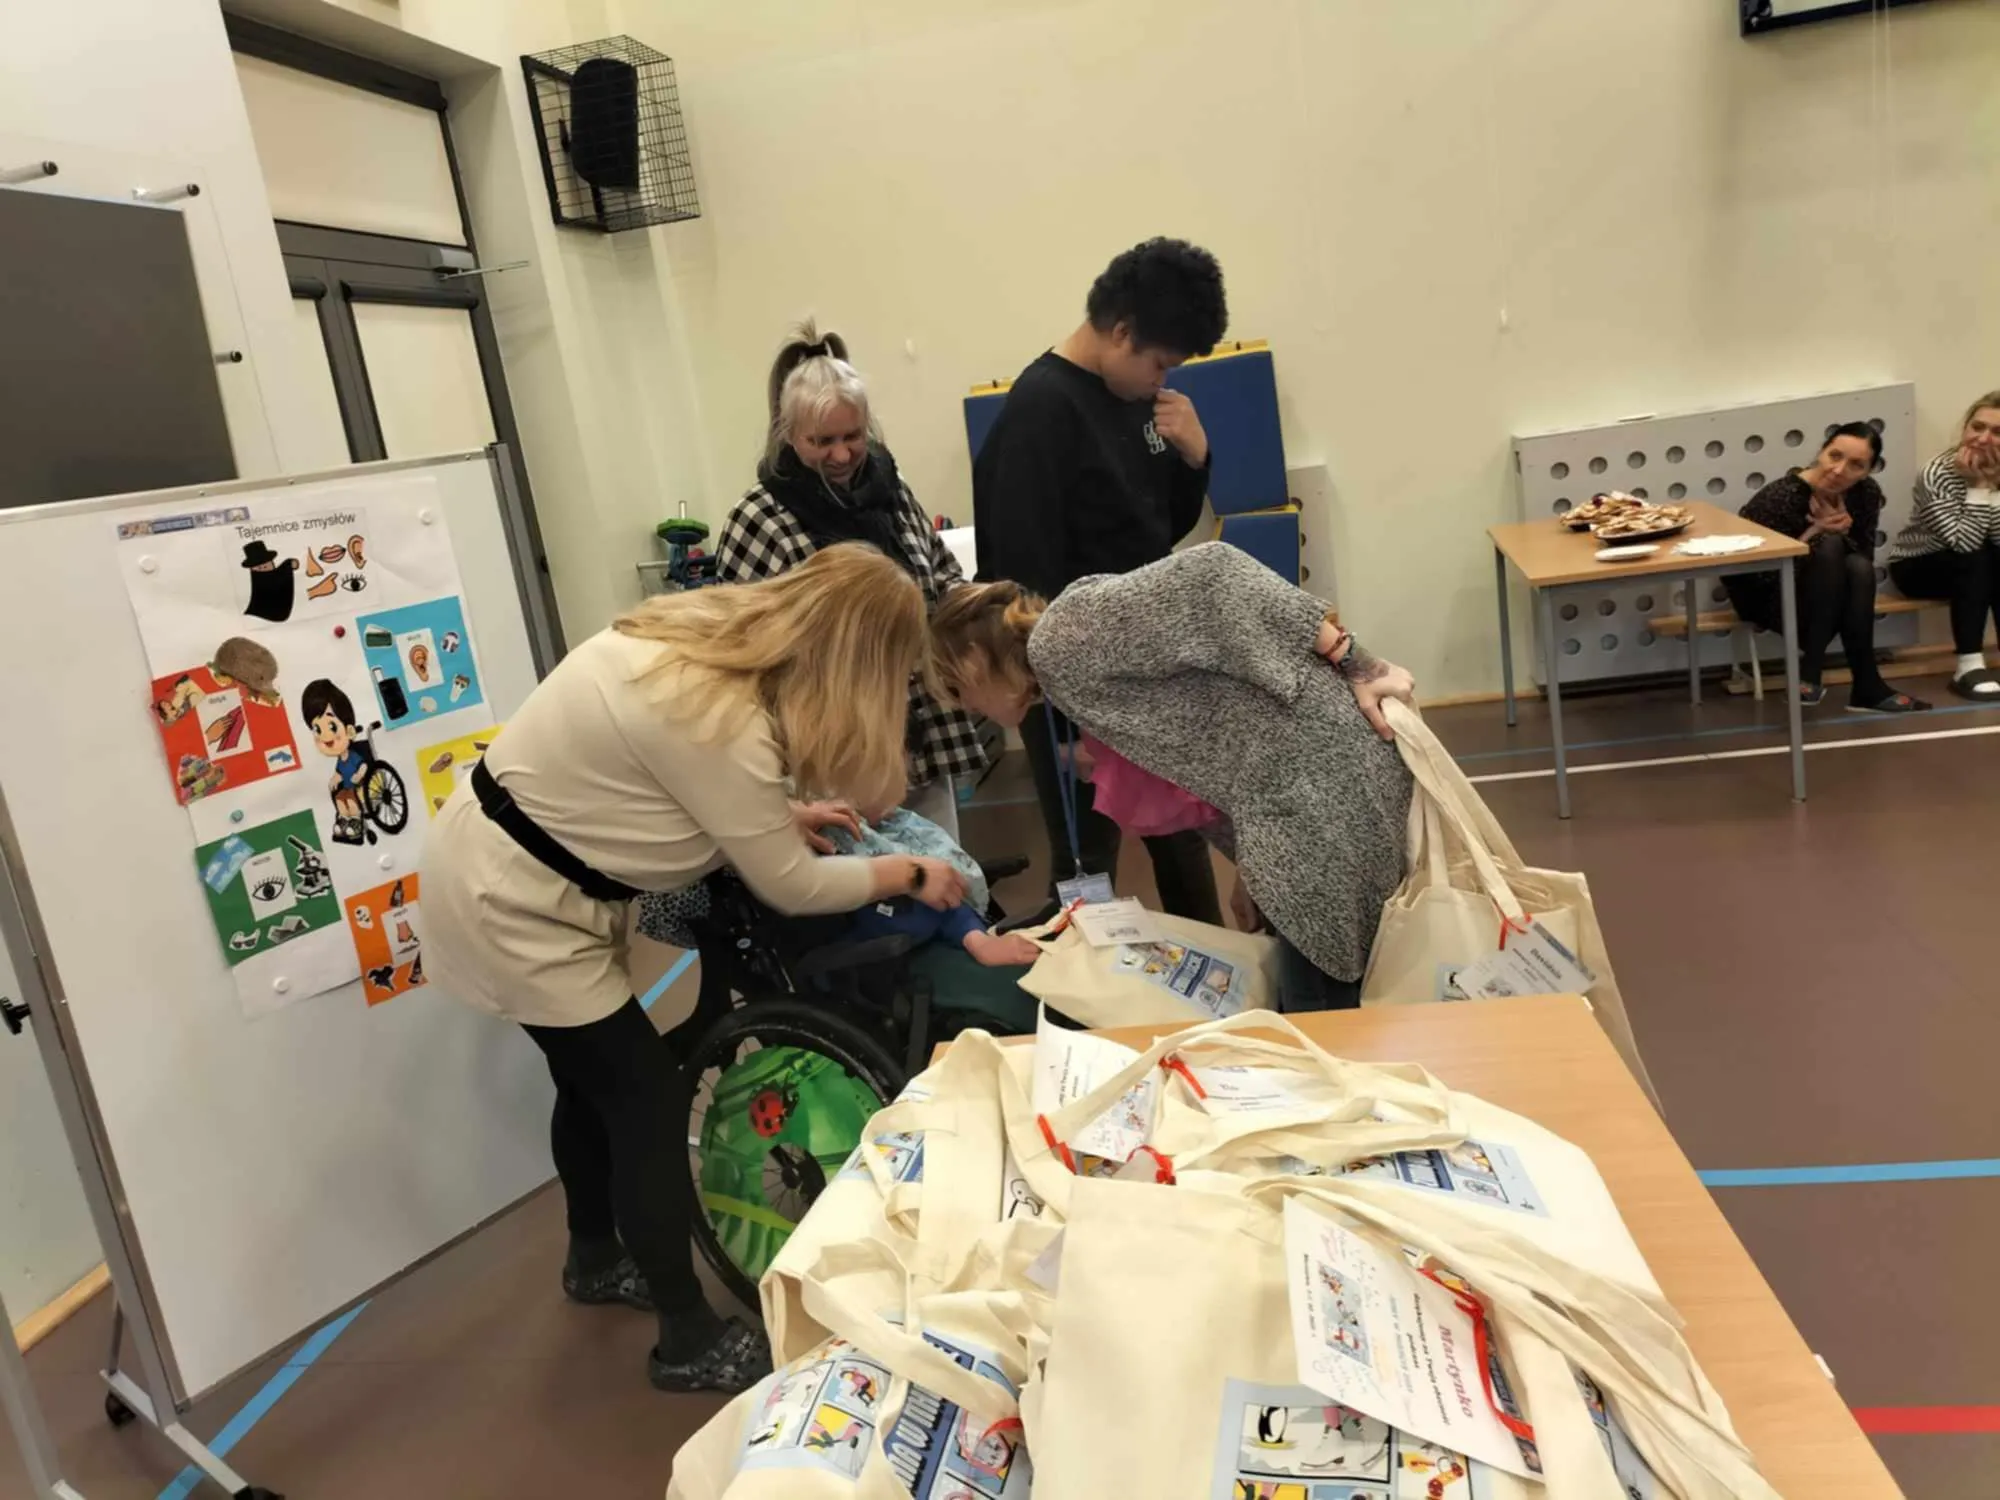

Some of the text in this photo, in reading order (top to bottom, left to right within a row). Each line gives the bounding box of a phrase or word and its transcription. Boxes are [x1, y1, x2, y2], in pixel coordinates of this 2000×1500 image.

[235, 511, 356, 540] Tajemnice zmysłów
[1438, 1323, 1474, 1419] Martynko
